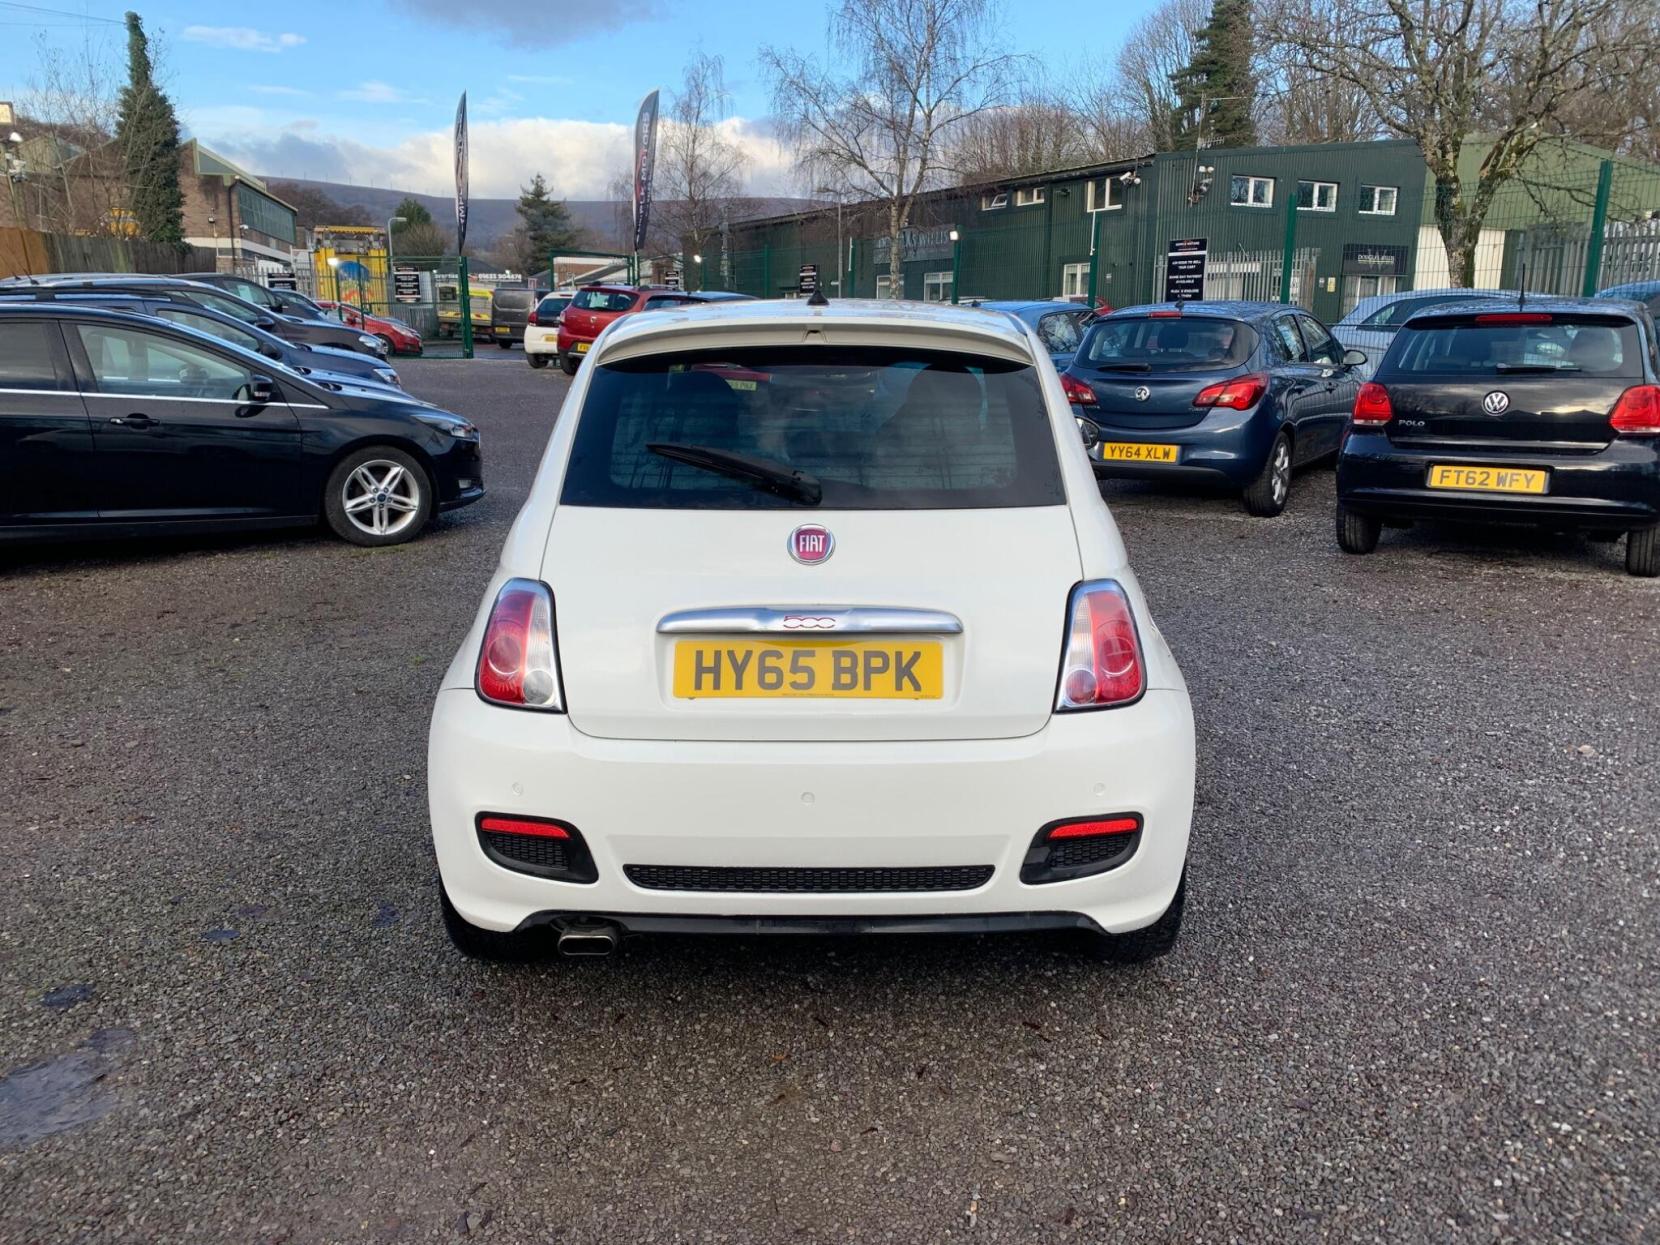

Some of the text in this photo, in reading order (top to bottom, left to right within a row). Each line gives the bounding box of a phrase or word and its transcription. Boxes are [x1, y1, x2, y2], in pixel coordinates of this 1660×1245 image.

[641, 111, 649, 181] MOTORS
[1398, 419, 1425, 427] POLO
[1109, 445, 1171, 460] YY64 XLW
[1439, 469, 1535, 489] FT62 WFY
[799, 535, 825, 552] FIAT
[783, 615, 836, 629] 500
[694, 649, 922, 692] HY65 BPK
